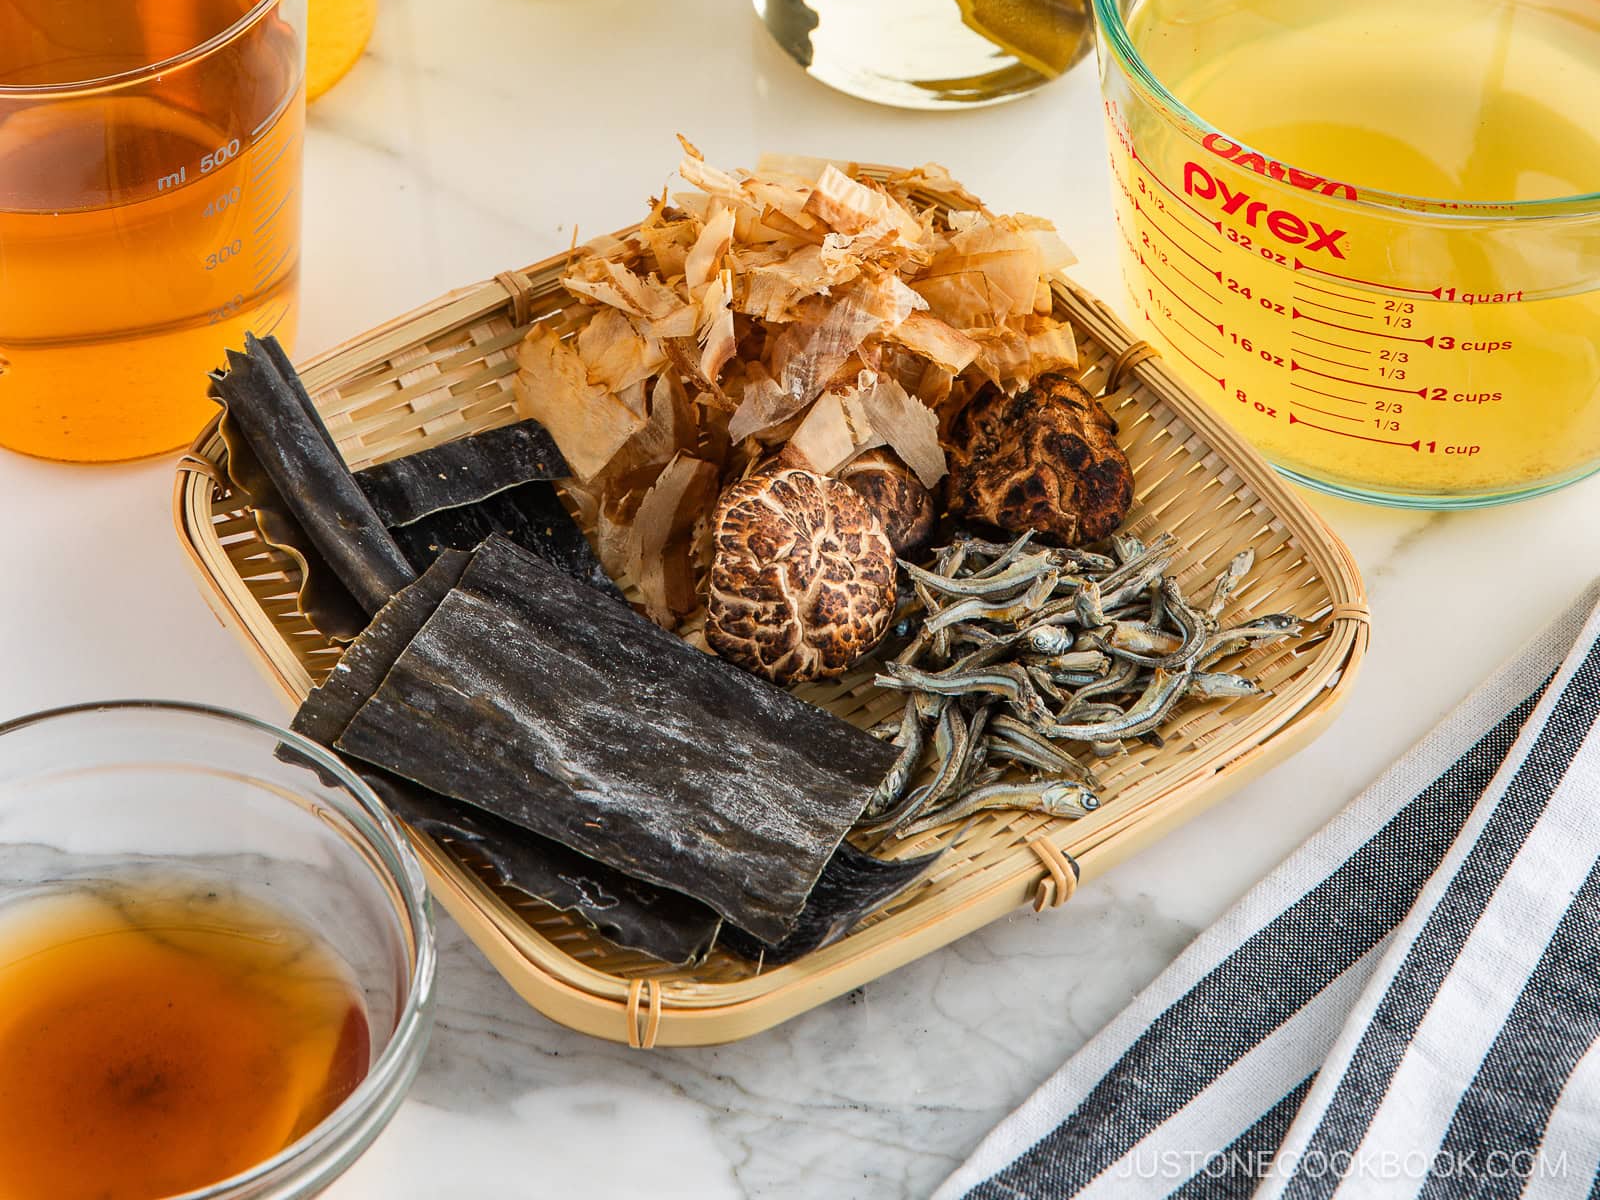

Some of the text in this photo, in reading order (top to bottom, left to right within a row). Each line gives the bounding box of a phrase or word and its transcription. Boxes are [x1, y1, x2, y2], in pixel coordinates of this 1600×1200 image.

[157, 138, 240, 191] ml 500
[203, 186, 241, 219] 400
[1183, 161, 1347, 260] pyrex
[205, 239, 242, 272] 300
[1227, 228, 1287, 266] 32 oz
[1227, 278, 1286, 315] 24 oz
[1445, 287, 1523, 306] 1 quart
[208, 293, 244, 326] 200
[1383, 300, 1415, 314] 2/3
[1383, 316, 1412, 329] 1/3
[1230, 332, 1285, 368] 16 oz
[1438, 336, 1513, 354] 3 cups
[1379, 349, 1409, 363] 2/3
[1378, 367, 1406, 380] 1/3
[1236, 389, 1277, 418] 8 oz
[1430, 387, 1503, 405] 2 cups
[1374, 400, 1403, 414] 2/3
[1373, 418, 1400, 432] 1/3
[1426, 440, 1481, 457] 1 cup
